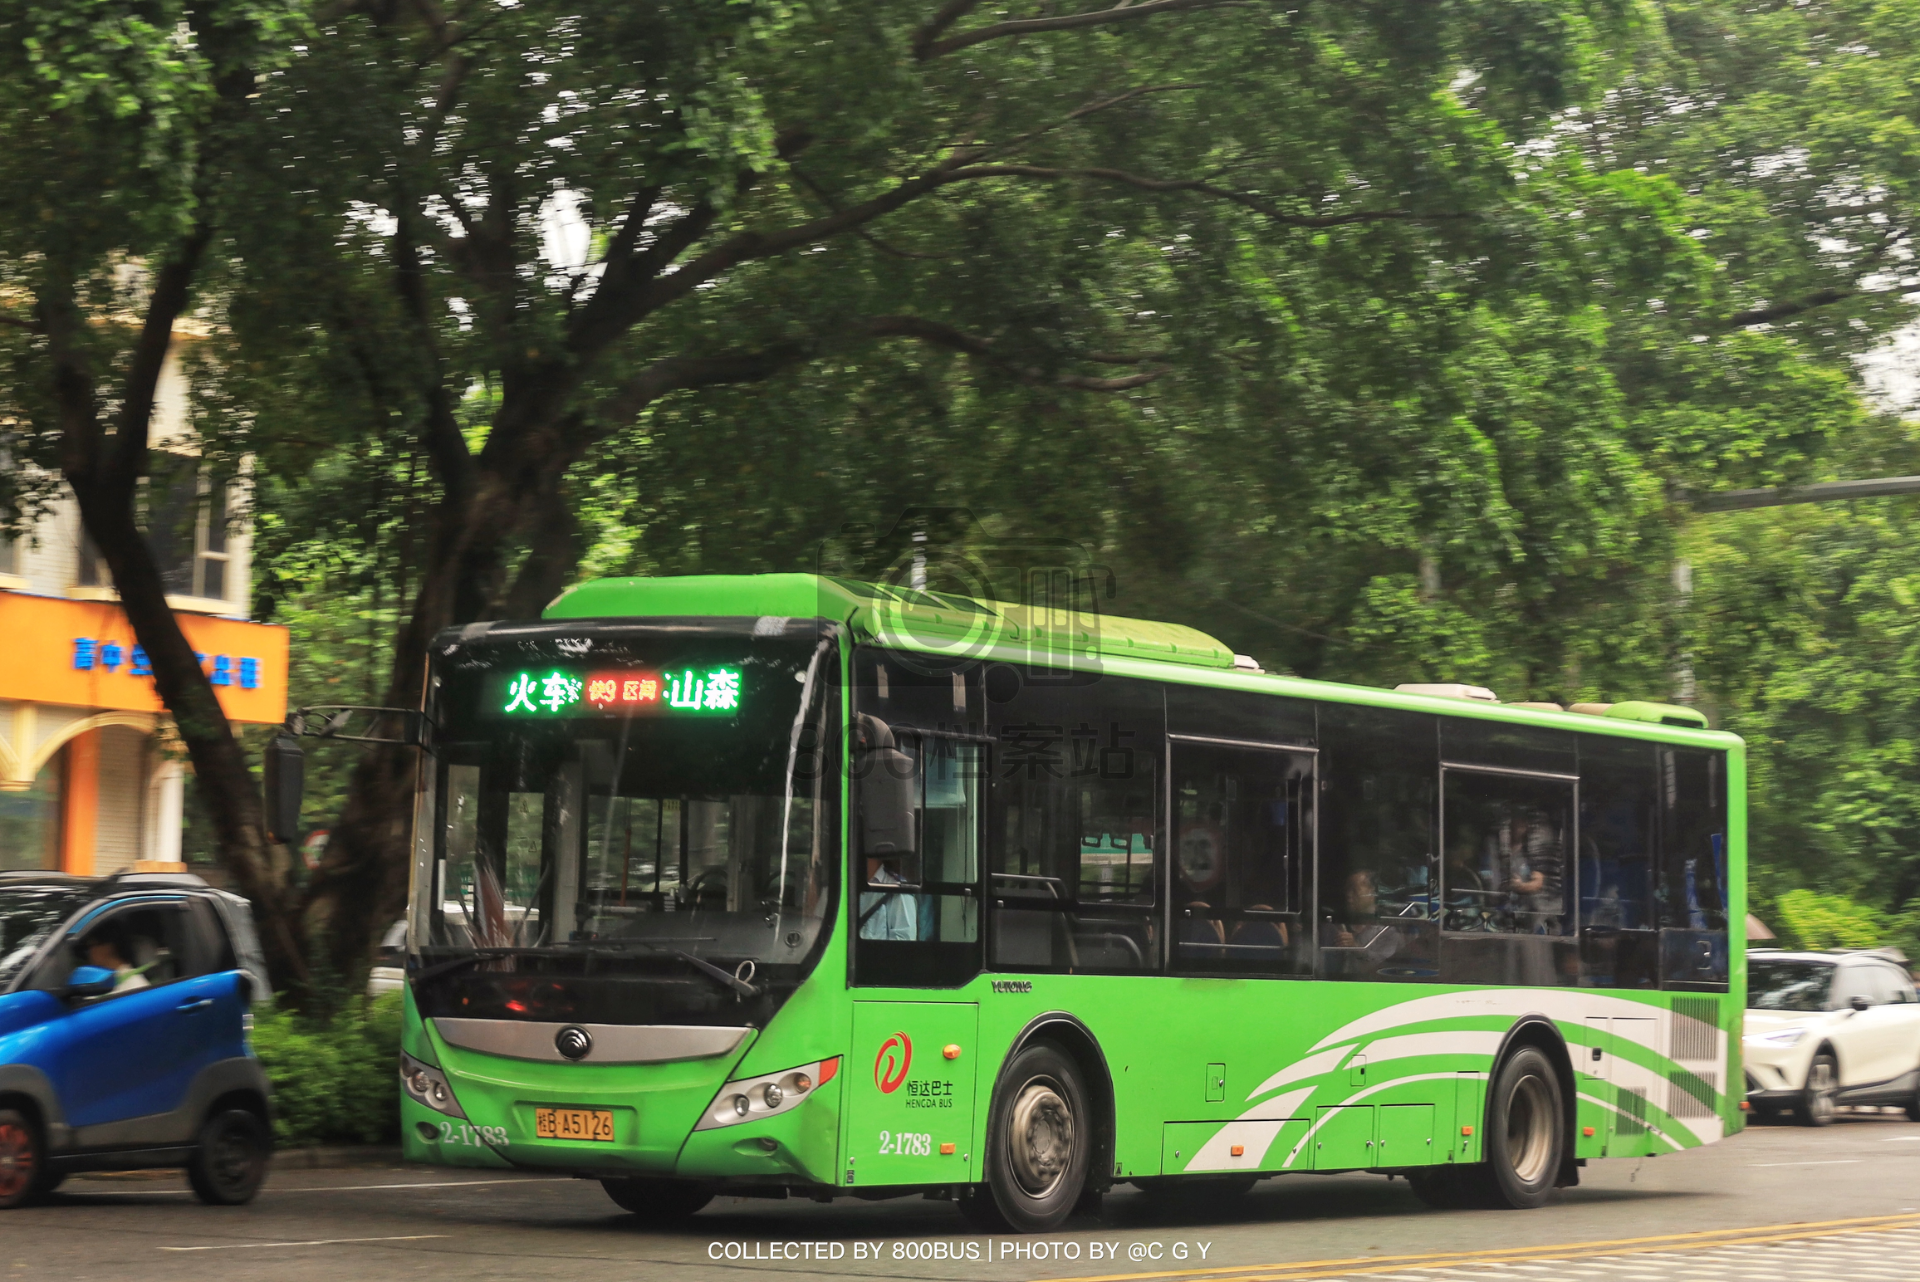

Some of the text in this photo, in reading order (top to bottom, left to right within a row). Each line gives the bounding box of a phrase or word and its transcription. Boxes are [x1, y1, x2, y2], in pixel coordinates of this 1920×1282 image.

[662, 668, 740, 710] 山森
[991, 980, 1032, 993] YUTONG
[907, 1080, 953, 1097] 恒达巴士
[906, 1098, 953, 1109] HENGDA BUS
[440, 1121, 510, 1147] 2-1783
[878, 1130, 932, 1156] 2-1783
